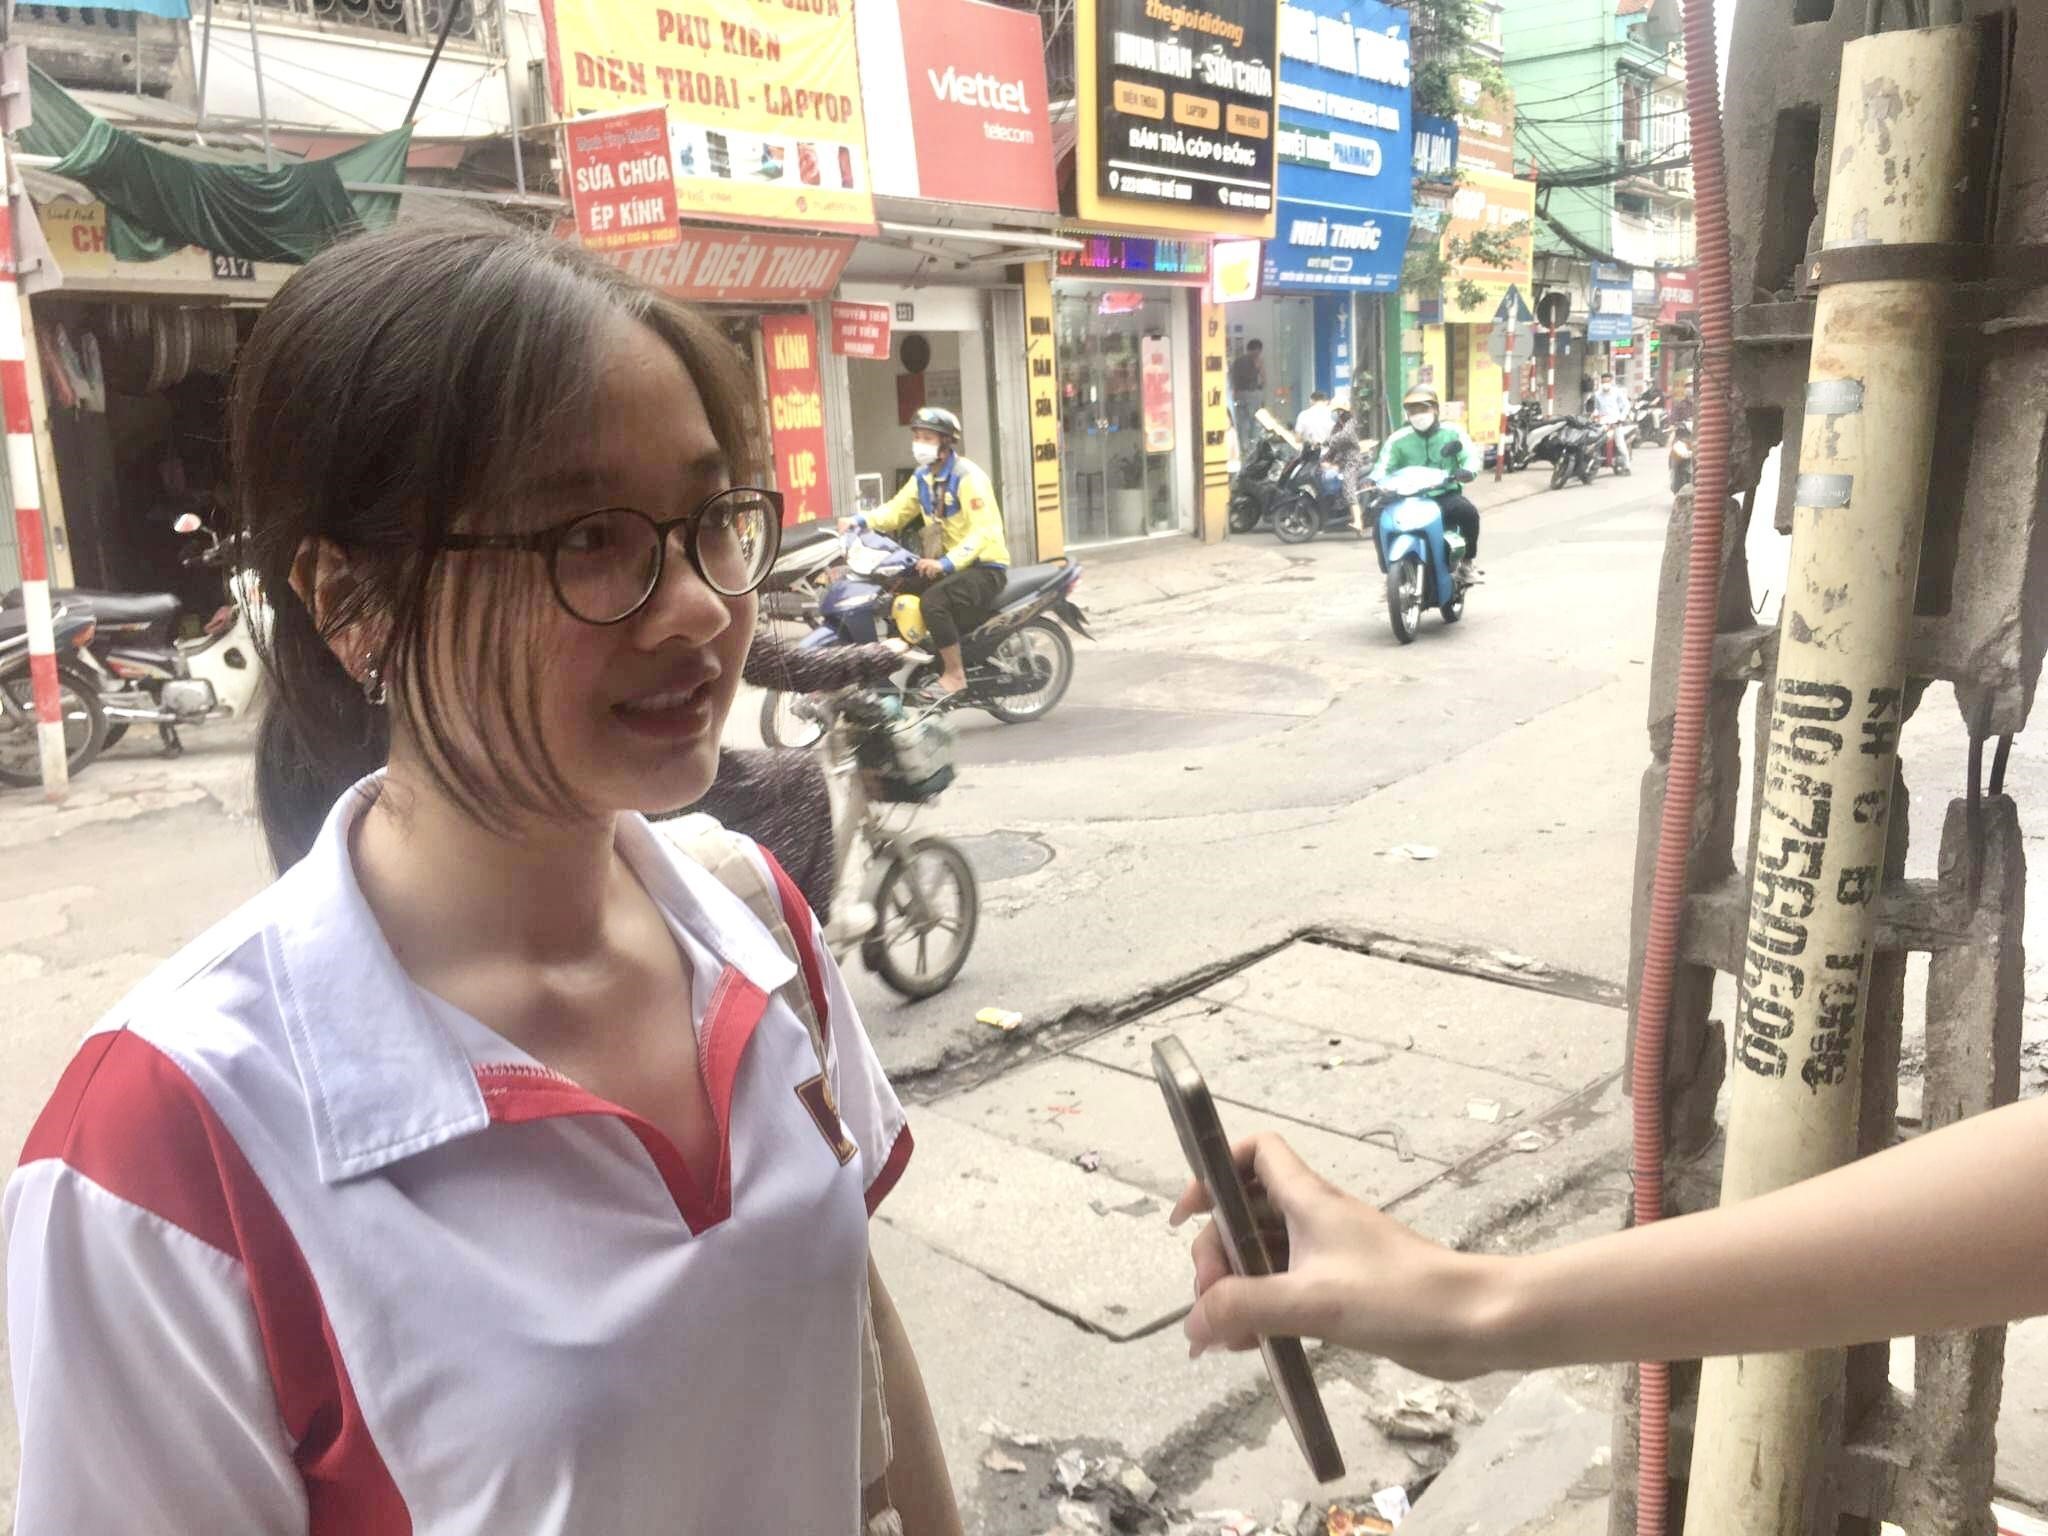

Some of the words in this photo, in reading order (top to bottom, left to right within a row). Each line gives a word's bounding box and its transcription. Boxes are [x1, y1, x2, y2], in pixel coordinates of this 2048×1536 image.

[764, 83, 853, 123] LAPTOP
[984, 121, 1034, 144] telecom
[1129, 126, 1159, 151] BÁN
[1160, 130, 1185, 155] TRẢ
[1186, 136, 1212, 158] GÓP
[576, 155, 615, 192] SỬA
[618, 151, 670, 187] CHỮA
[590, 201, 614, 231] ÉP
[620, 195, 666, 227] KÍNH
[1289, 217, 1328, 247] NHÀ
[1330, 220, 1382, 251] THUỐC
[215, 256, 249, 276] 217
[761, 246, 840, 297] THOẠI
[774, 328, 810, 370] KÍNH
